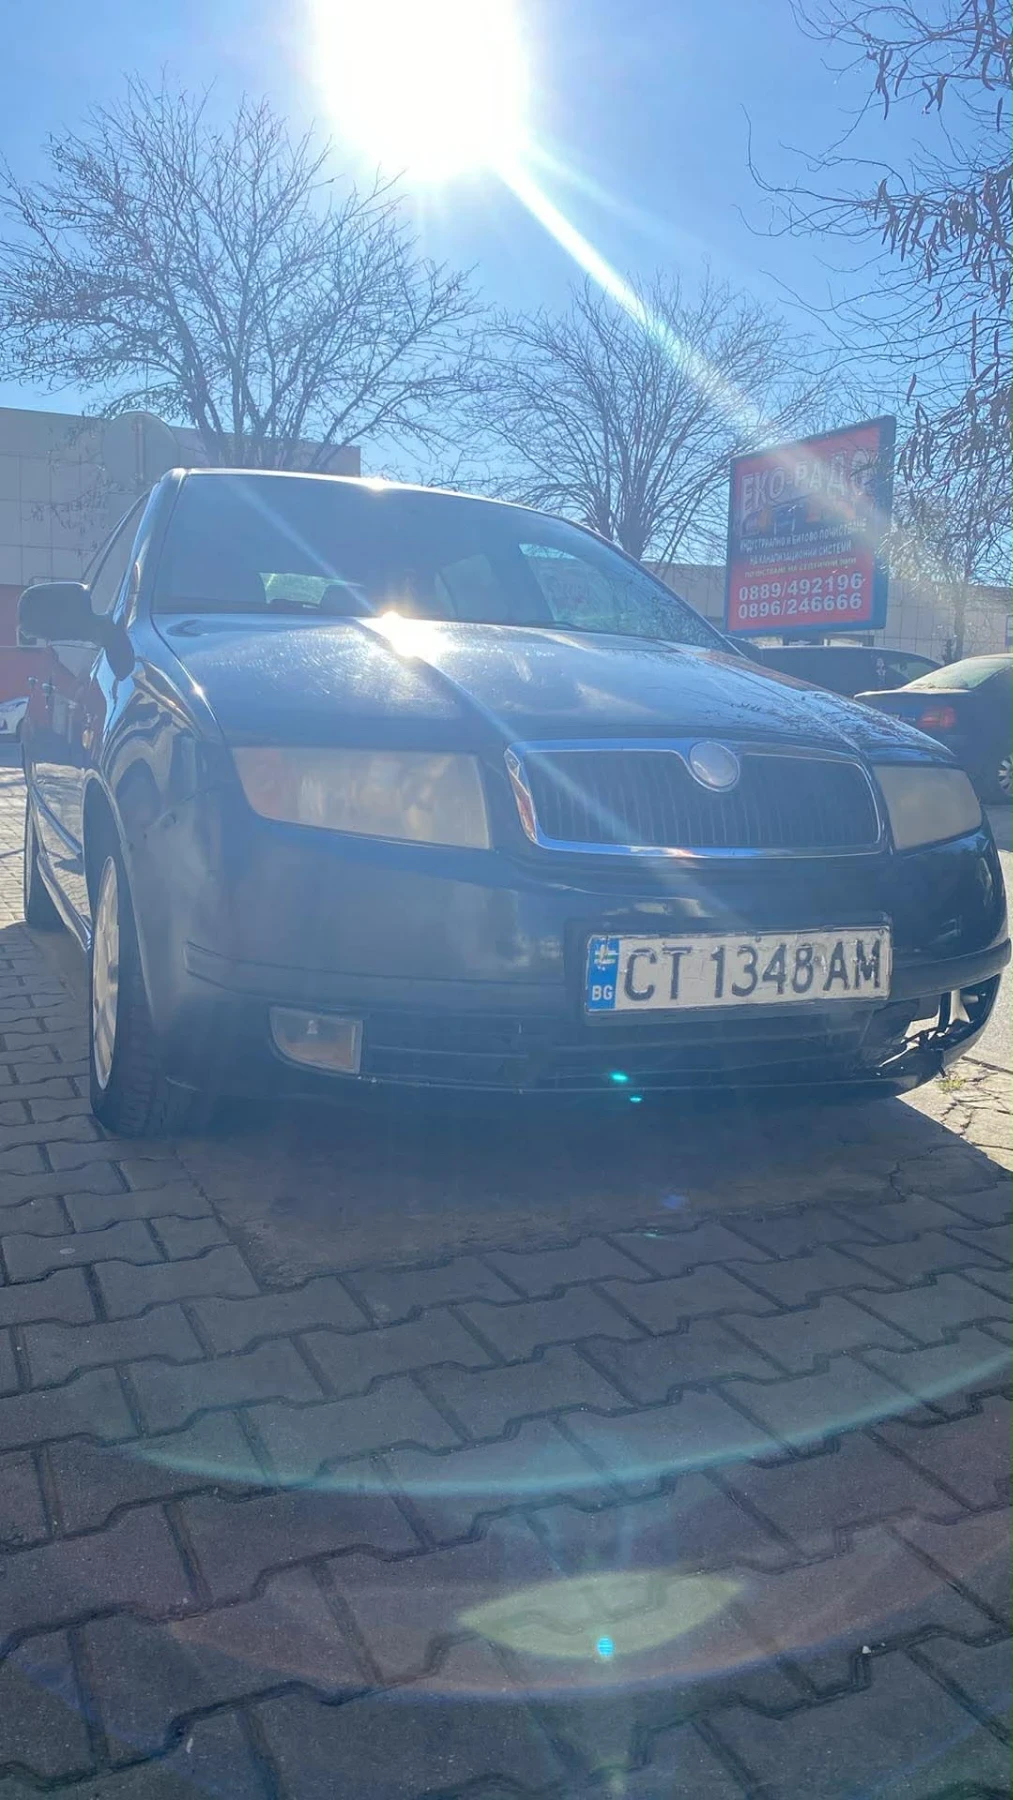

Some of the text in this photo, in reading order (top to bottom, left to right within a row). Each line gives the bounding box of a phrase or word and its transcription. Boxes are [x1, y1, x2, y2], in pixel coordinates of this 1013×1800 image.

[739, 572, 863, 601] 0889/492196
[738, 592, 862, 619] 0896/246666
[710, 943, 814, 999] 1348
[823, 938, 881, 991] AM
[592, 984, 613, 1001] BG
